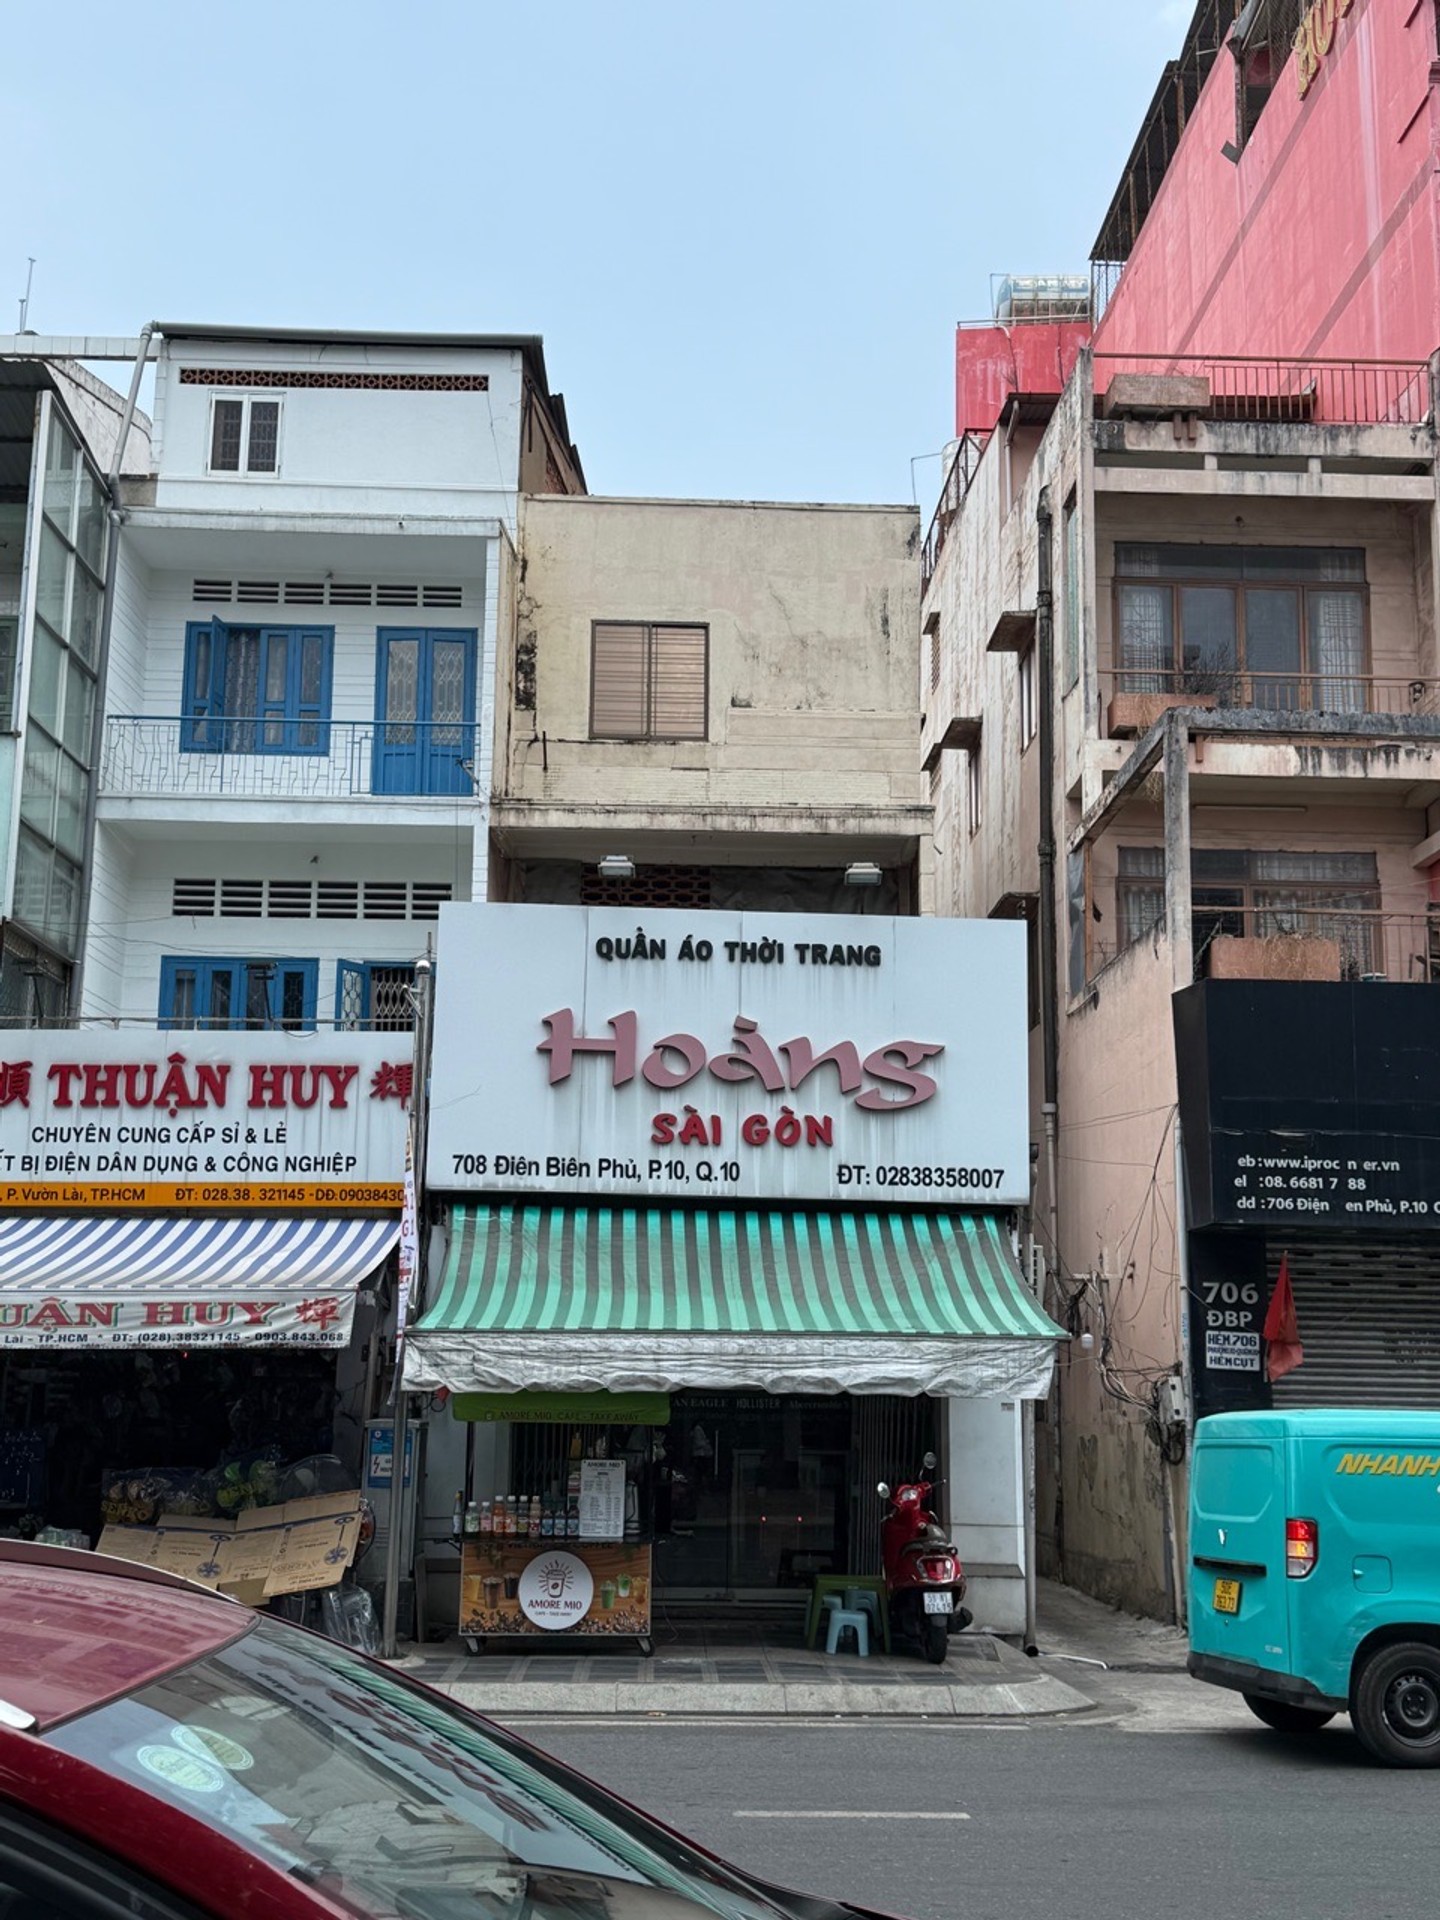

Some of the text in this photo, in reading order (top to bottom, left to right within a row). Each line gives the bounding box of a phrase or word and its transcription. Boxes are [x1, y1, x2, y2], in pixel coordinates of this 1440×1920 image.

[595, 927, 881, 967] QUẦN ÁO THỜI TRANG
[536, 1007, 945, 1111] Hoàng
[47, 1051, 360, 1118] THUẬN HUY
[31, 1121, 288, 1144] CHUYÊN CUNG CẤP SỈ & LẺ
[650, 1105, 834, 1147] SÀI GÒN
[21, 1155, 39, 1175] BỊ
[45, 1151, 90, 1175] ĐIỆN
[97, 1151, 137, 1172] DÂN
[143, 1156, 198, 1176] DỤNG
[204, 1157, 217, 1172] &
[223, 1152, 278, 1173] CÔNG
[285, 1151, 357, 1176] NGHIỆP
[452, 1154, 487, 1175] 708
[546, 1156, 590, 1178] Biên
[598, 1158, 641, 1183] Phủ,
[696, 1160, 740, 1182] Q.10
[837, 1164, 1004, 1189] ĐT: 02838358007
[7, 1188, 19, 1201] P.
[22, 1187, 59, 1201] Vườn
[90, 1188, 146, 1201] TP.HCM
[175, 1187, 198, 1201] ĐT:
[258, 1187, 305, 1201] 321145
[1297, 1198, 1330, 1215] Điện
[1366, 1199, 1397, 1215] Phủ,
[1202, 1281, 1259, 1305] 706
[140, 1301, 285, 1328] HUY
[1206, 1310, 1253, 1328] ĐBP
[38, 1333, 88, 1344] TP.HCM
[1336, 1453, 1440, 1477] NHANH
[528, 1599, 582, 1610] AMORE MIO
